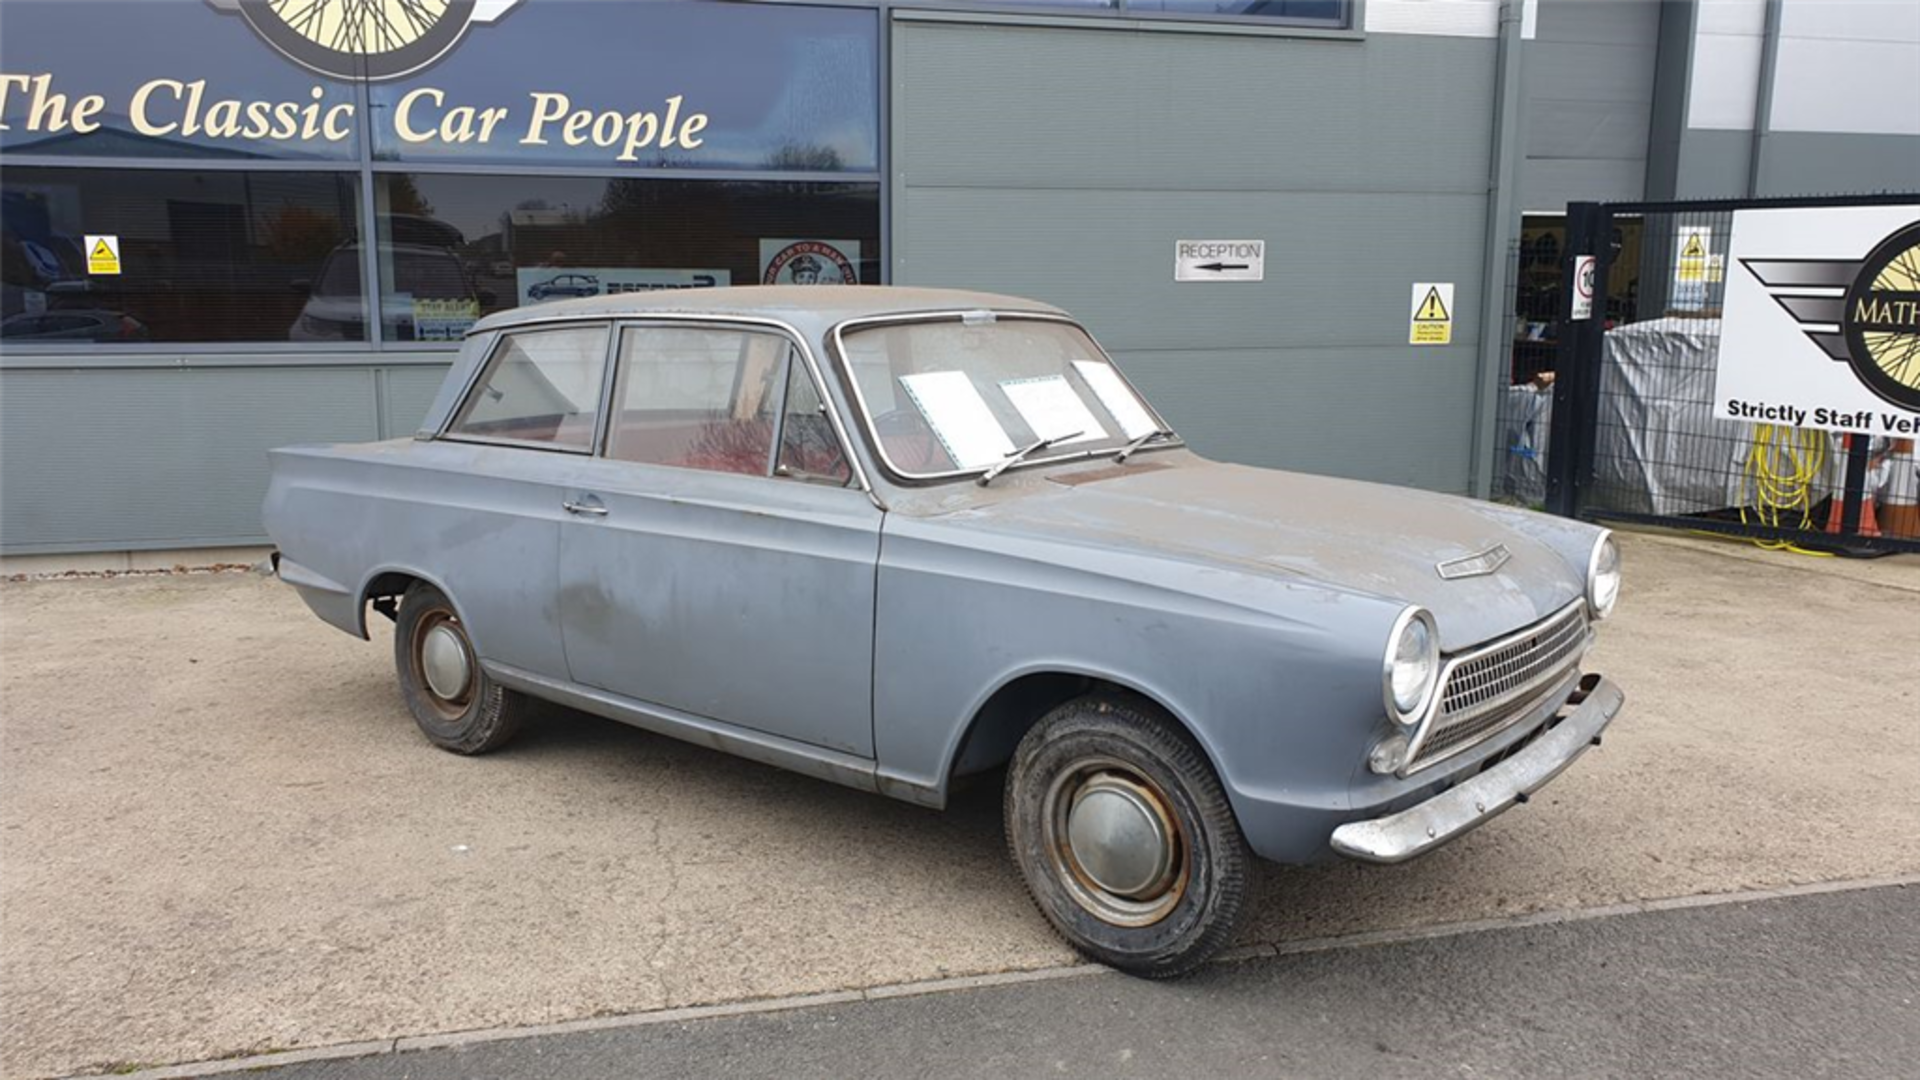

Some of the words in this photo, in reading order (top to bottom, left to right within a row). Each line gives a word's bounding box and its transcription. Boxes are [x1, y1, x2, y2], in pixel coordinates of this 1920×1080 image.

[0, 73, 105, 134] The
[129, 79, 354, 140] Classic
[393, 87, 508, 144] Car
[519, 92, 709, 161] People
[1180, 243, 1261, 259] RECEPTION
[1727, 399, 1806, 427] Strictly
[1814, 407, 1873, 429] Staff
